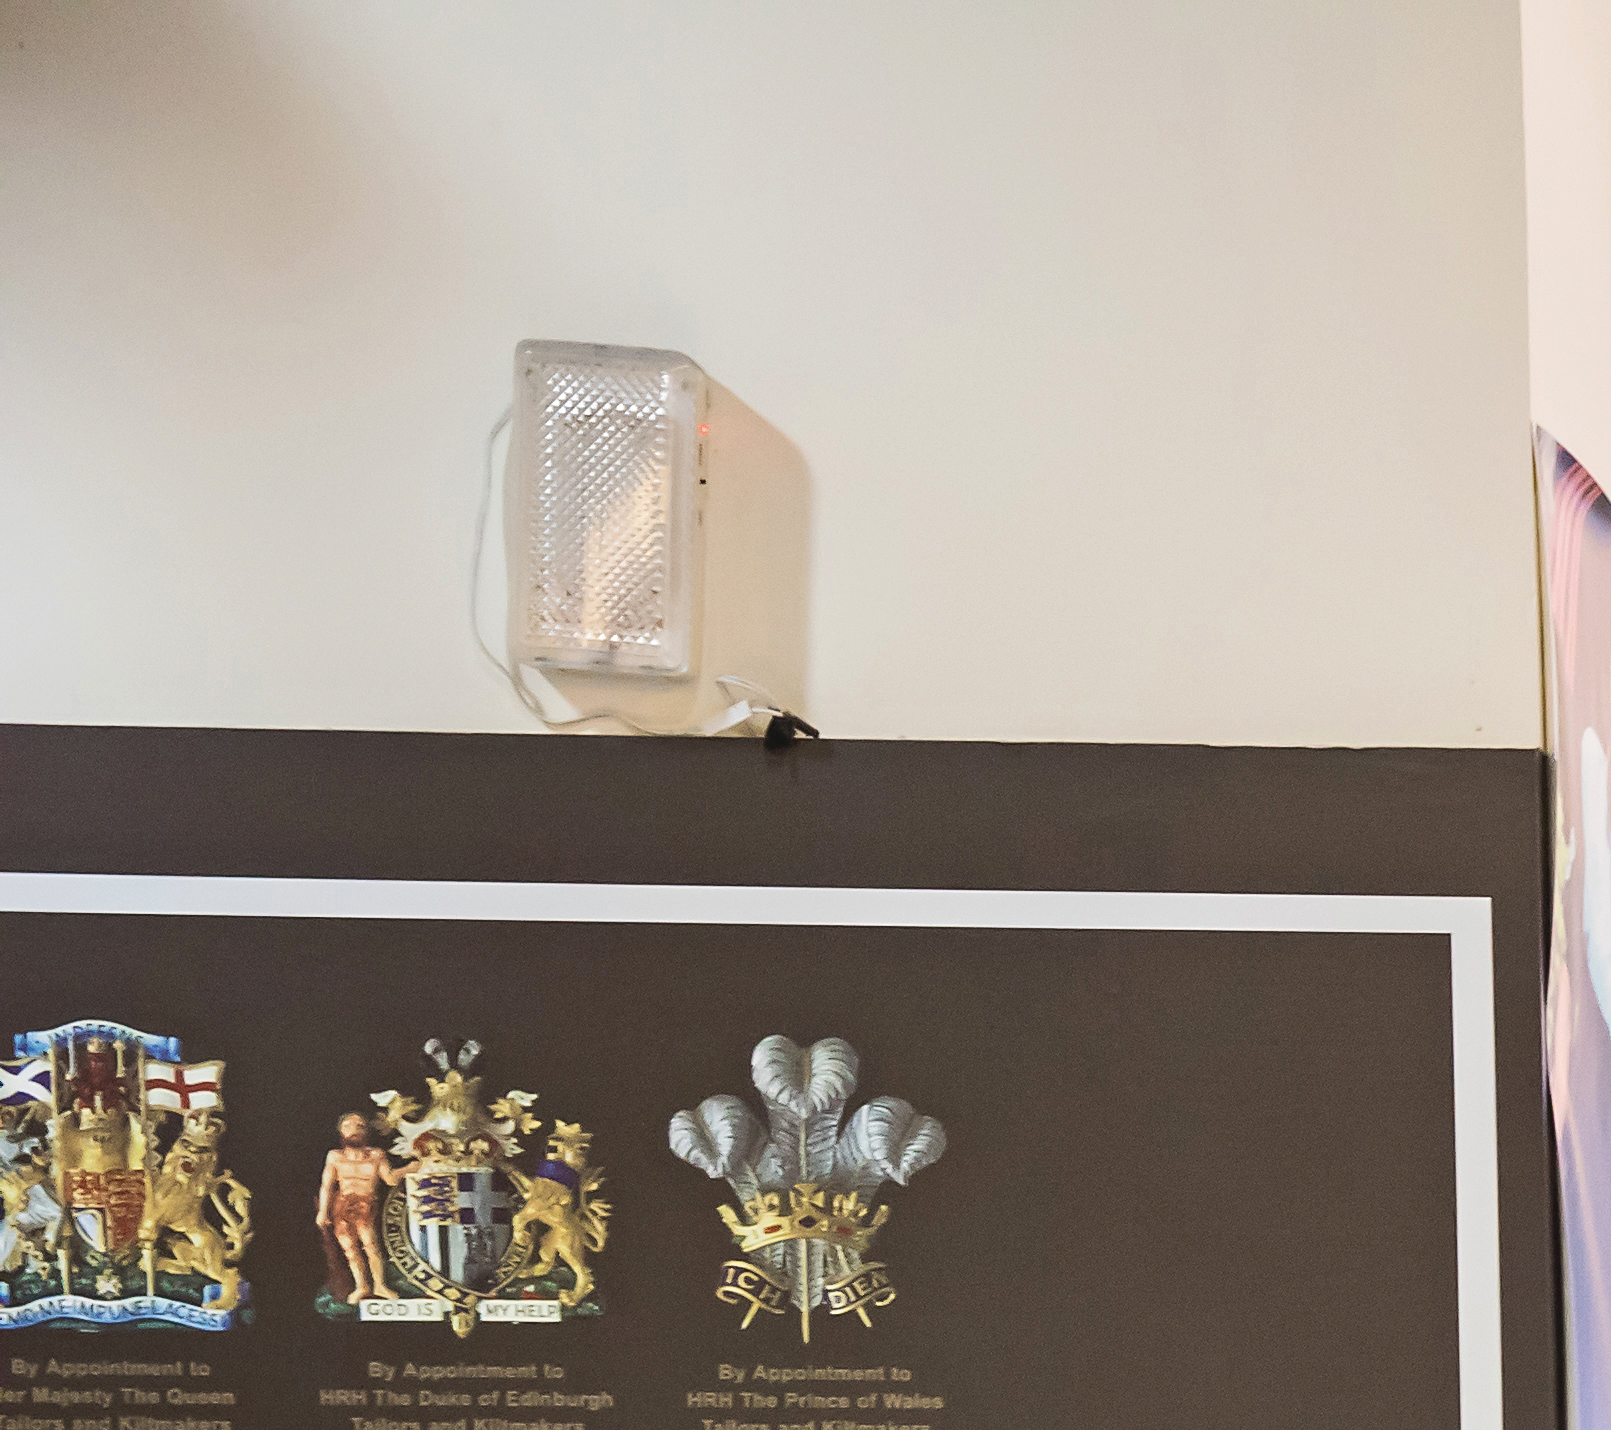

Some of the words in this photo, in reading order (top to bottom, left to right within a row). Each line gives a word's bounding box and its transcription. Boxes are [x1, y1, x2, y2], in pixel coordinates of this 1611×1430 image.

[725, 1267, 782, 1307] ICH
[367, 1302, 408, 1316] GOD
[417, 1302, 434, 1316] IS
[10, 1358, 39, 1378] By
[46, 1357, 183, 1378] Appointment
[190, 1361, 211, 1376] to
[368, 1362, 396, 1381] By
[402, 1362, 538, 1381] Appointment
[543, 1363, 565, 1379] to
[718, 1364, 746, 1383] By
[752, 1364, 886, 1383] Appointment
[890, 1365, 912, 1382] to
[32, 1387, 112, 1408] Majesty
[120, 1388, 160, 1404] The
[166, 1388, 236, 1405] Queen
[319, 1389, 367, 1406] HRH
[373, 1389, 412, 1407] The
[419, 1390, 472, 1407] Duke
[477, 1390, 499, 1407] of
[505, 1390, 614, 1411] Edinburgh
[686, 1391, 733, 1409] HRH
[739, 1392, 778, 1409] The
[784, 1392, 850, 1409] Prince
[856, 1393, 878, 1409] of
[882, 1393, 945, 1410] Wales
